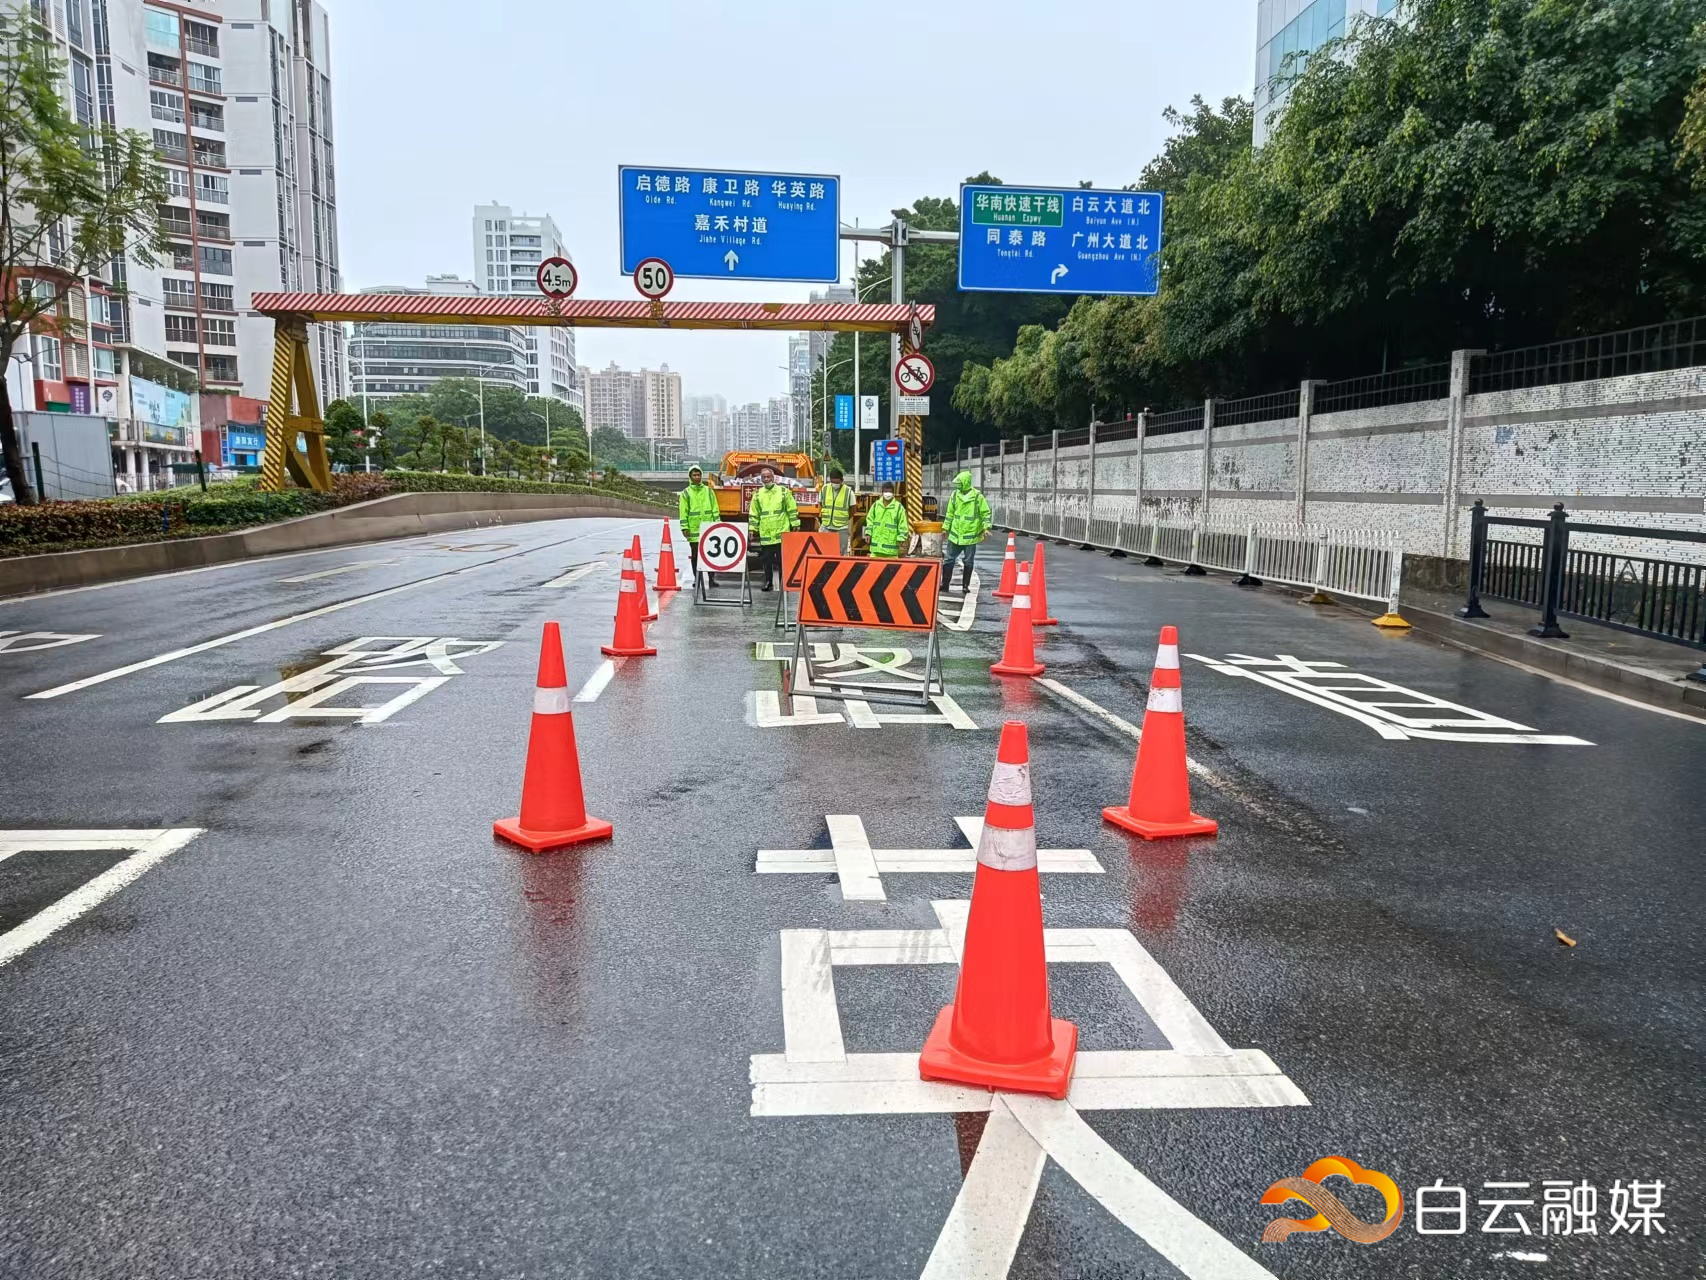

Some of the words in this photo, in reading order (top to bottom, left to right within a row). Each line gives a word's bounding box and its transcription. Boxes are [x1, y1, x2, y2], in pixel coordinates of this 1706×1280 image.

[635, 174, 691, 194] 启德路
[702, 176, 760, 197] 康卫路
[771, 180, 825, 200] 华英路
[666, 195, 677, 205] Rd.
[709, 198, 736, 209] Kangwei
[742, 199, 753, 208] Rd.
[778, 201, 804, 213] Huaying
[806, 202, 817, 211] Rd.
[976, 194, 1060, 215] 华南快速干线
[1072, 196, 1151, 216] 白云大道北
[694, 213, 768, 234] 嘉禾村道
[993, 212, 1016, 222] Huanan
[1022, 213, 1042, 224] Expwy
[699, 235, 717, 244] Jiahe
[720, 236, 746, 247] Village
[986, 228, 1047, 247] 同泰路
[1071, 231, 1149, 251] 广州大道北
[542, 269, 571, 288] 4.5m
[643, 267, 666, 290] 50
[706, 535, 739, 559] 30
